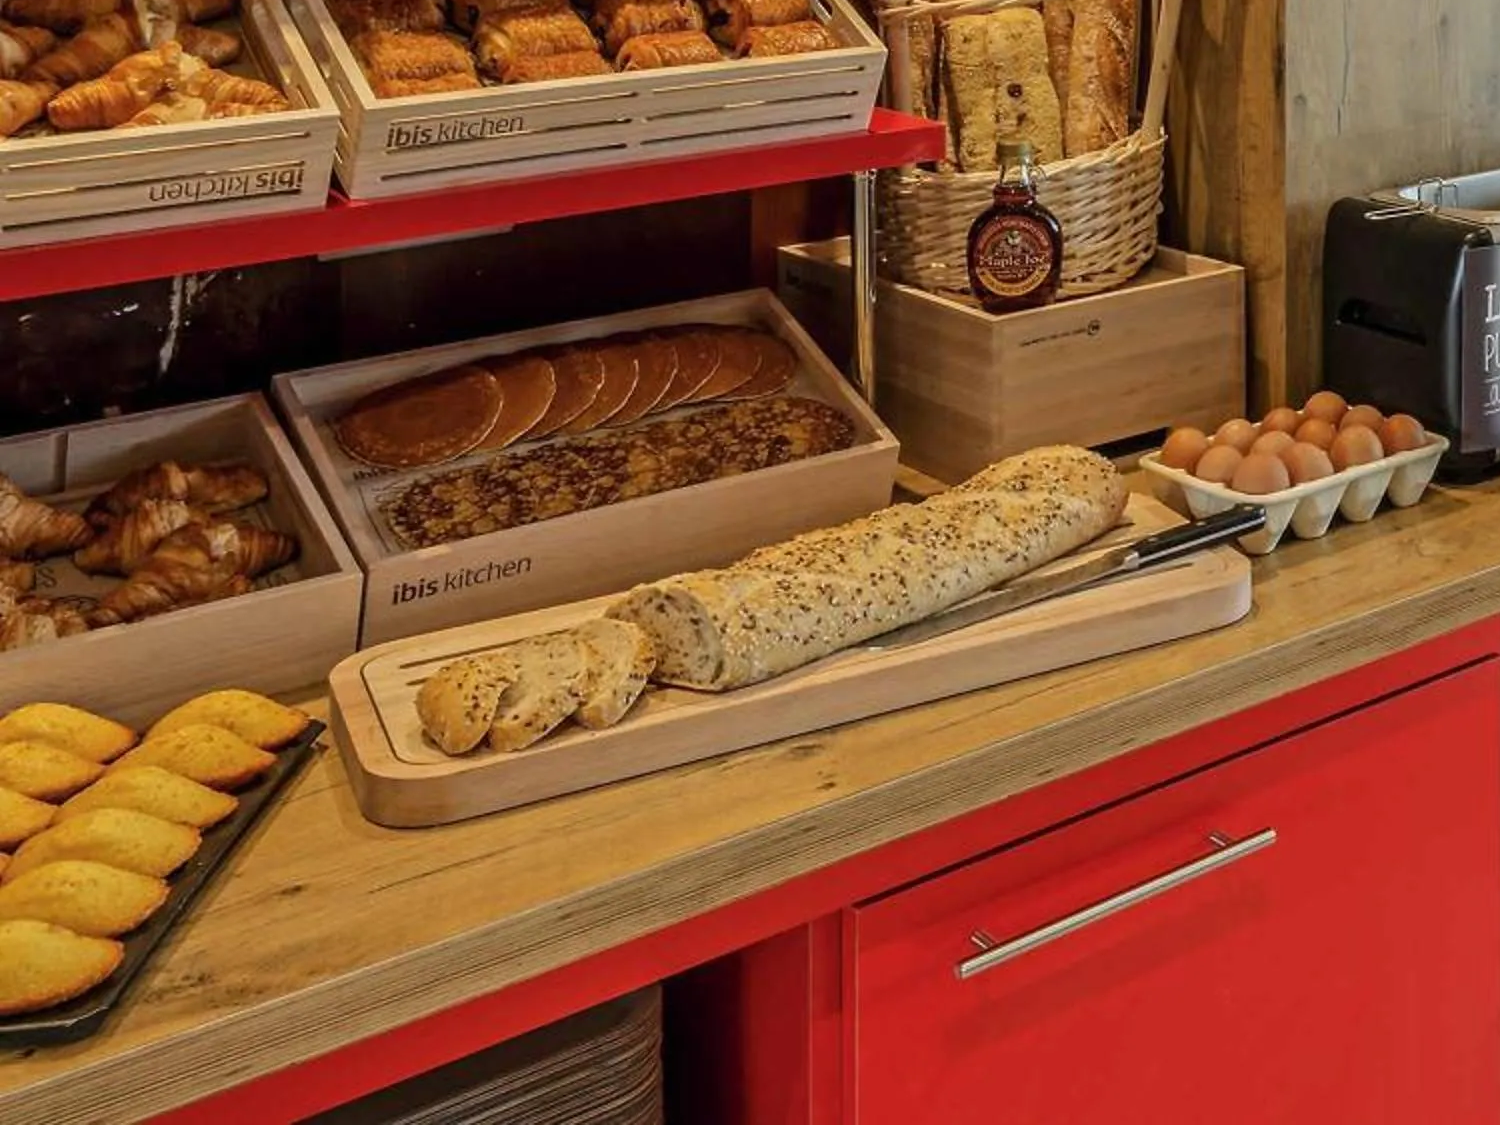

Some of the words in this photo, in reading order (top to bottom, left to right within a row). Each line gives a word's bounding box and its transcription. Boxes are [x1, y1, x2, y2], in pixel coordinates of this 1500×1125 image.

[386, 123, 433, 148] ibis
[436, 115, 524, 142] kitchen
[149, 175, 249, 202] kitchen
[255, 168, 305, 190] ibis
[392, 578, 439, 606] ibis
[443, 557, 532, 593] kitchen
